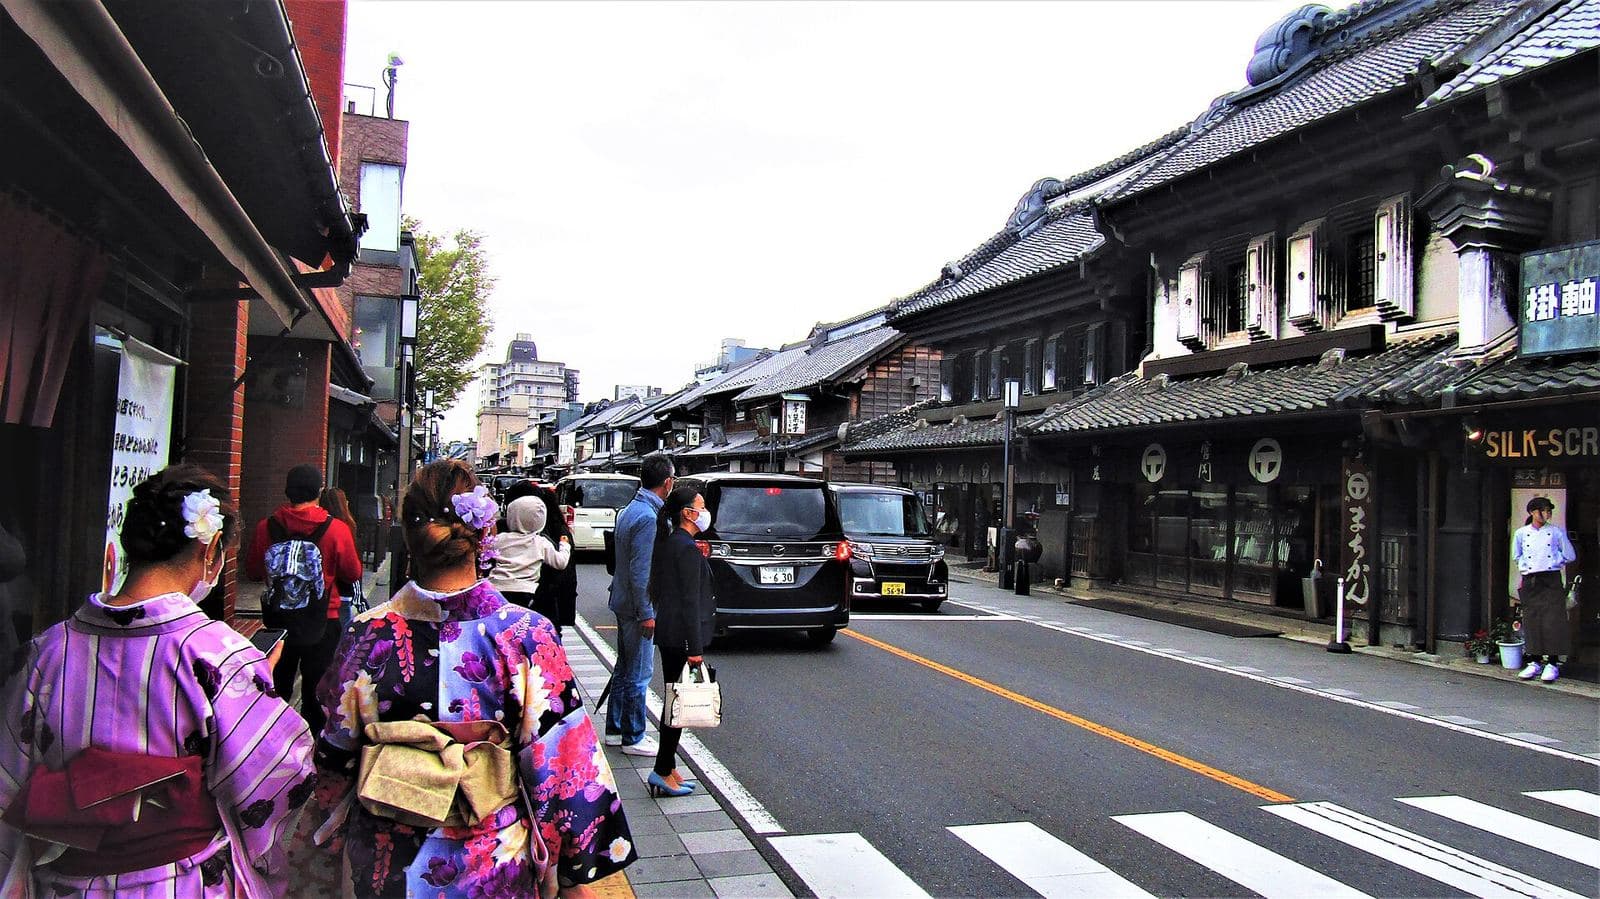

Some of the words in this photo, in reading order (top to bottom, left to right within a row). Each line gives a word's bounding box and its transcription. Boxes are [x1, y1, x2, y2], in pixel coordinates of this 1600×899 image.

[1526, 278, 1597, 322] 掛軸
[1346, 506, 1370, 605] まちかん
